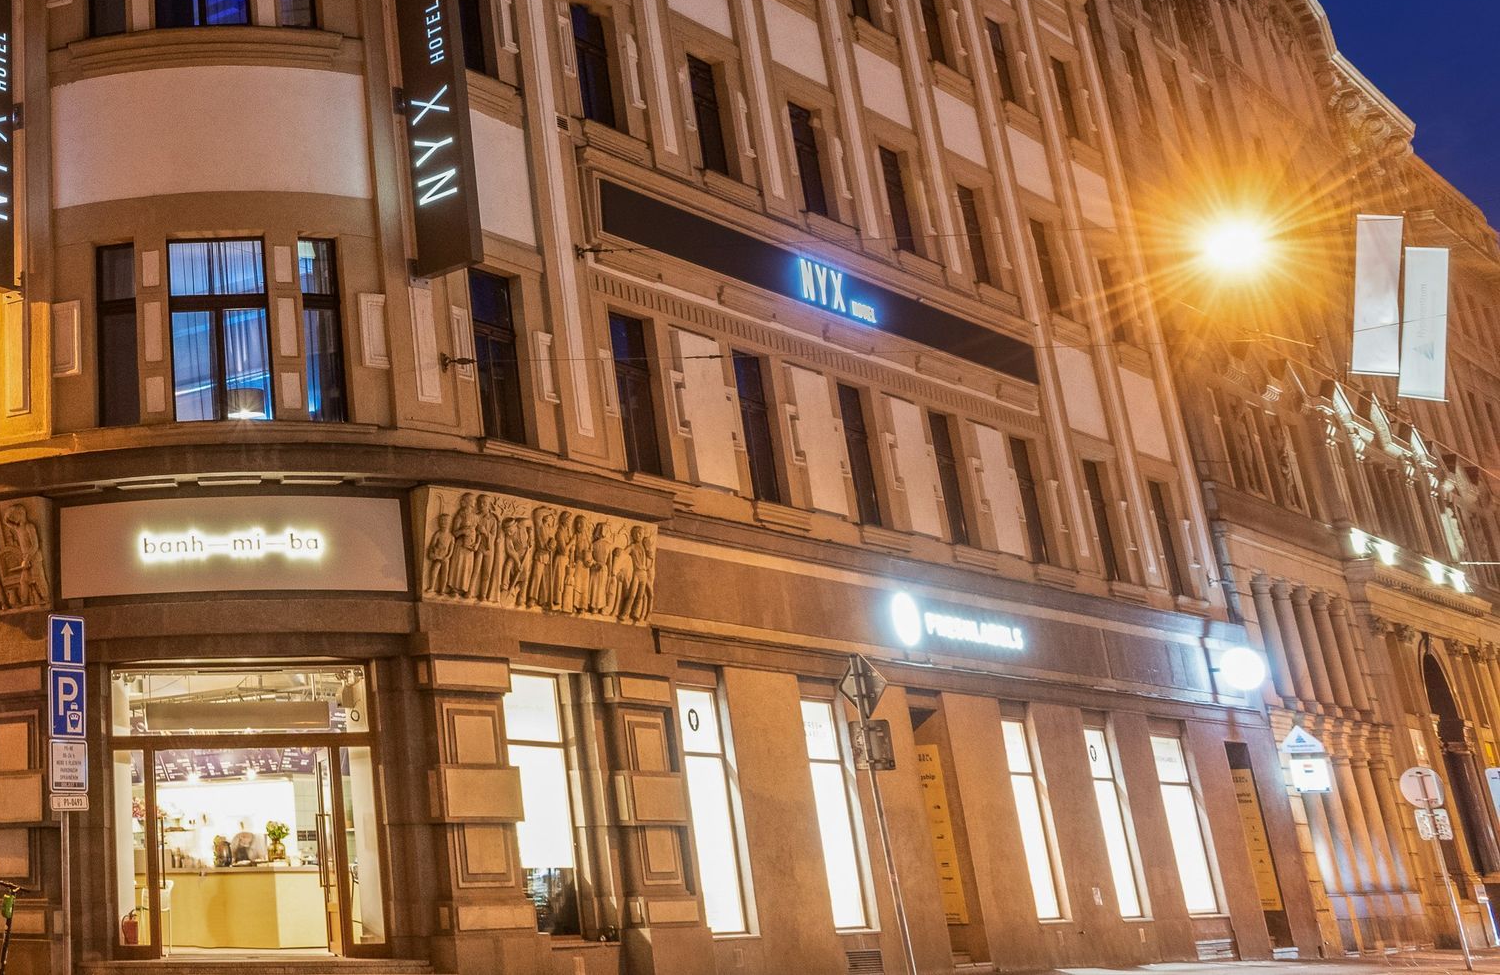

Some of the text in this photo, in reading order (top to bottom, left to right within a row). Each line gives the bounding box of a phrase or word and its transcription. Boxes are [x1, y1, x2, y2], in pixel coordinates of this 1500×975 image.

[409, 83, 459, 207] NYX
[799, 257, 847, 313] NYX
[58, 676, 79, 716] P
